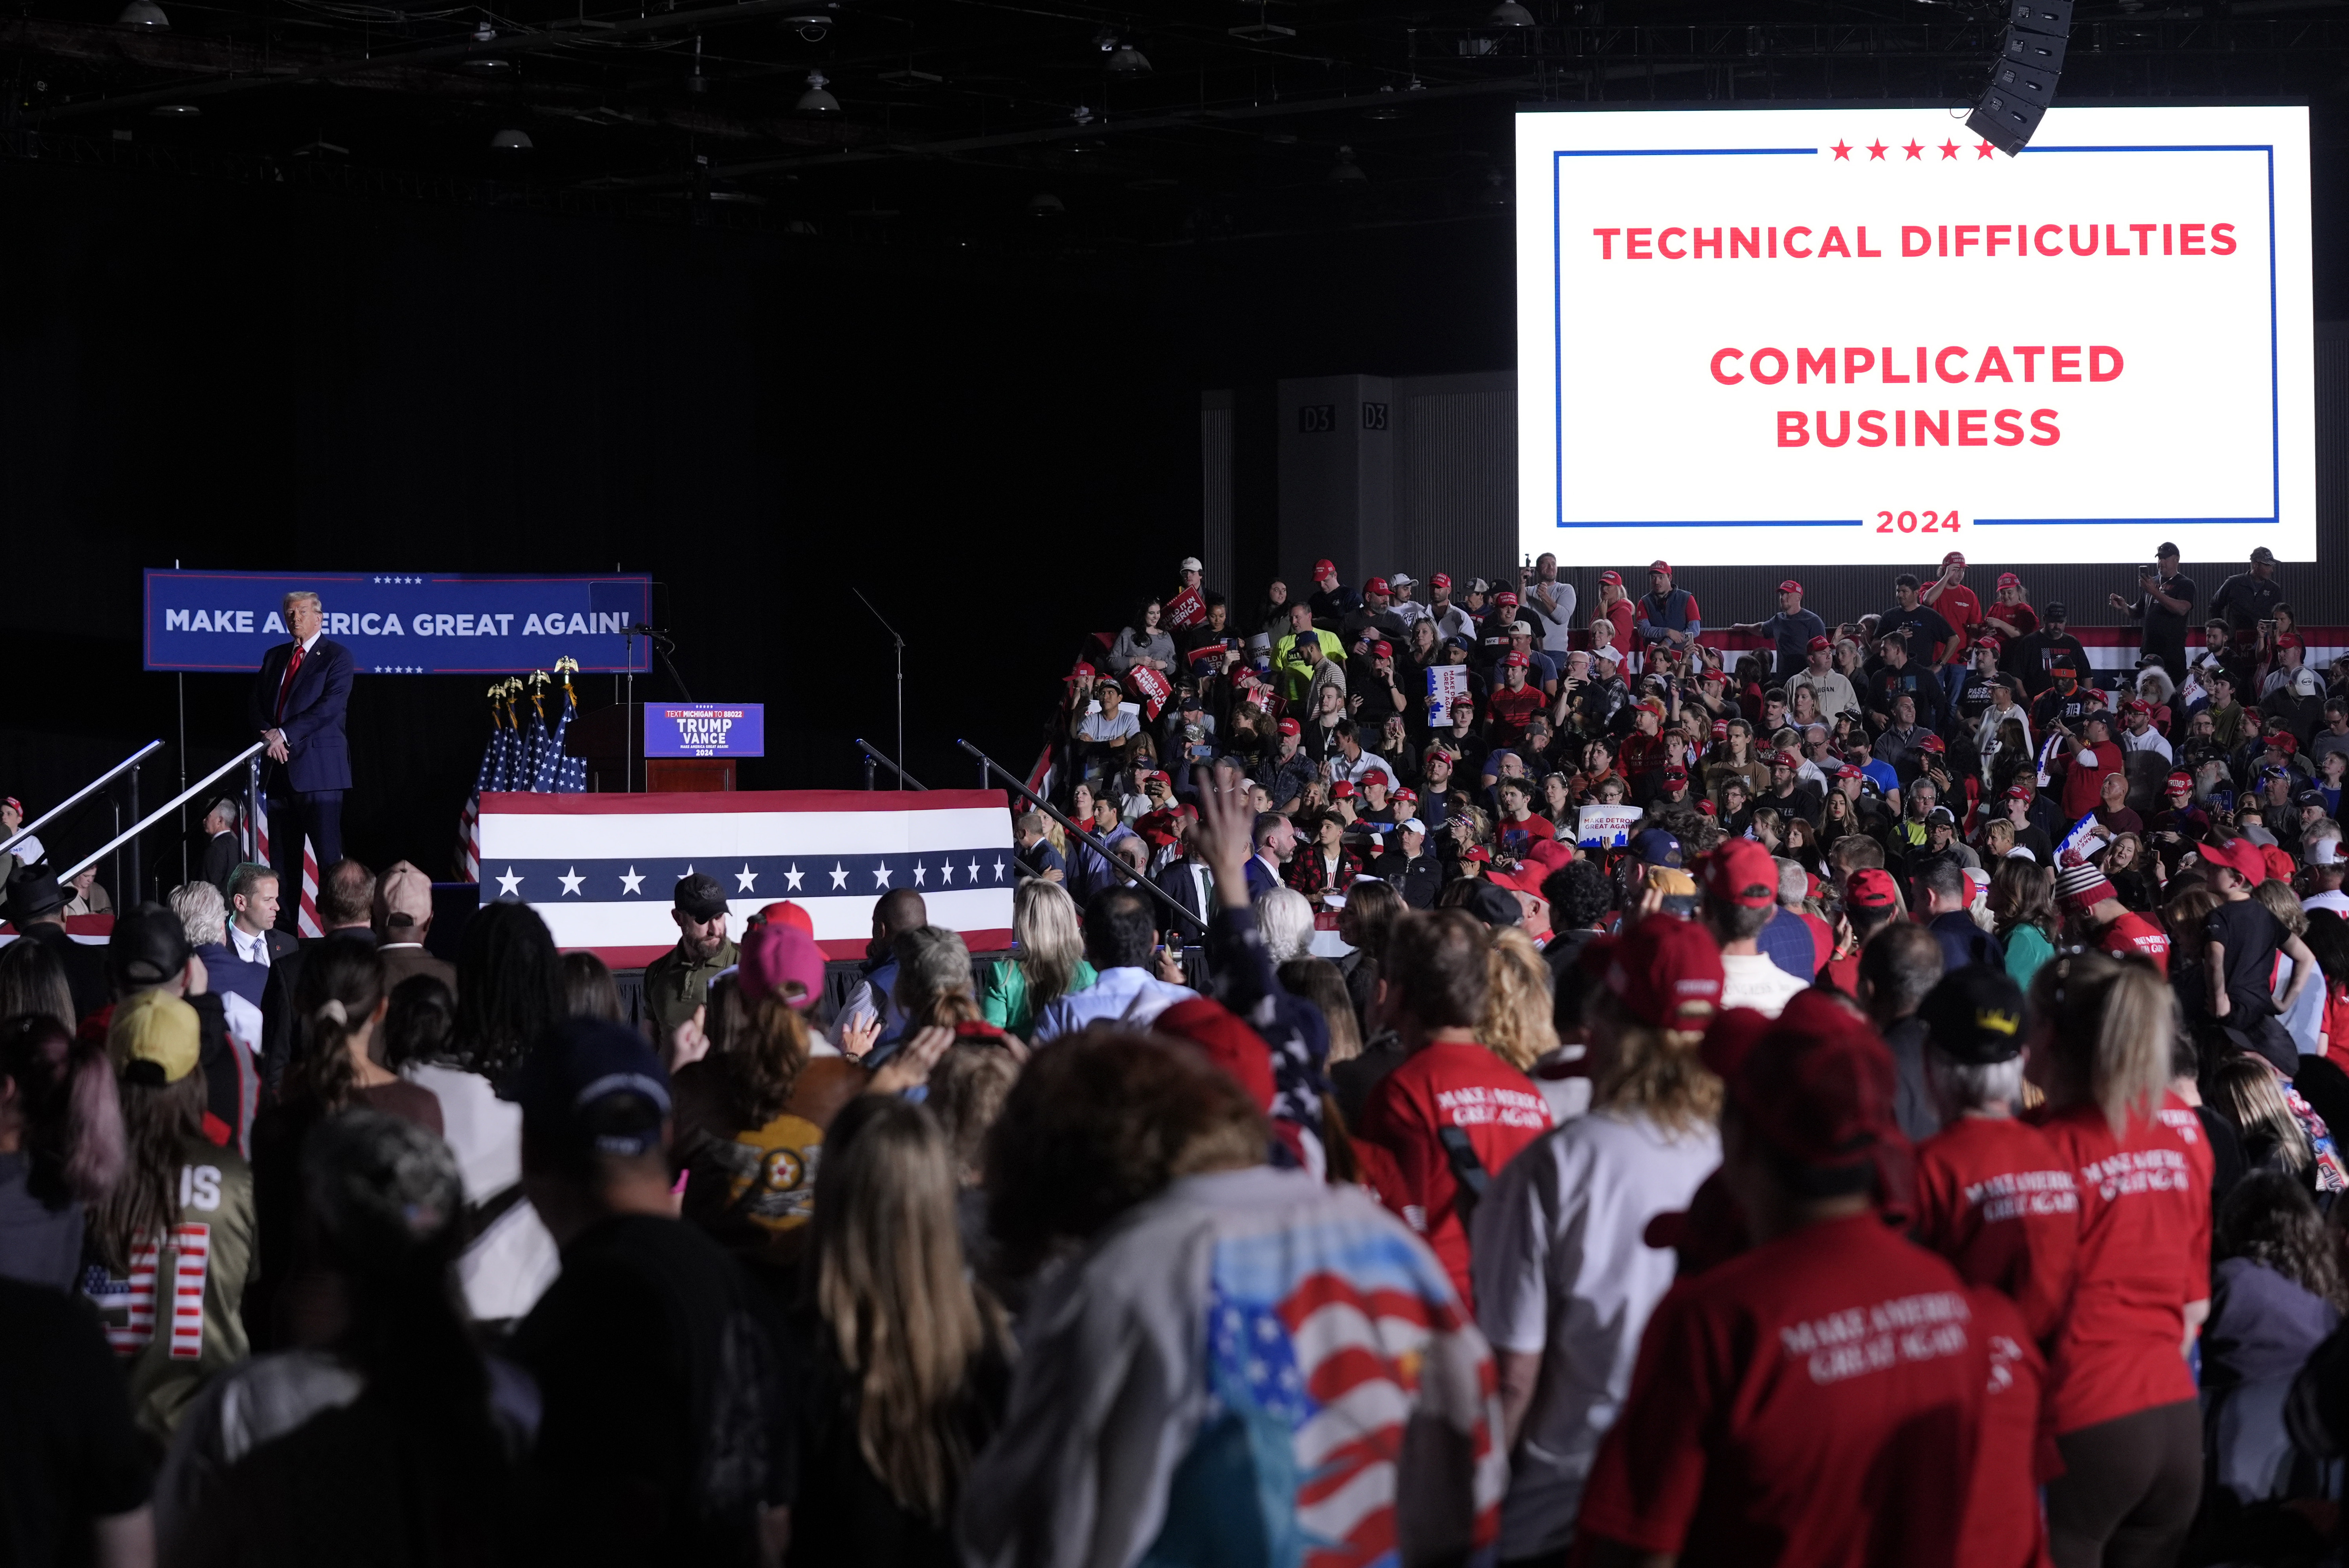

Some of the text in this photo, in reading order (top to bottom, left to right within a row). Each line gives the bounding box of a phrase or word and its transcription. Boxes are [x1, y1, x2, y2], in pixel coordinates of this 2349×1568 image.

[1594, 223, 2236, 259] TECHNICAL DIFFICULTIES
[1711, 346, 2124, 385] COMPLICATED
[1306, 406, 1328, 431] D3
[1366, 404, 1384, 429] D3
[1778, 409, 2060, 447] BUSINESS
[1877, 511, 1960, 533] 2024
[1187, 596, 1195, 605] IN
[166, 609, 629, 636] MAKE AERICA GREAT AGAIN!
[1134, 672, 1163, 711] AMERICA
[1140, 667, 1158, 689] BUILD
[1157, 688, 1164, 696] IT
[677, 719, 732, 732] TRUMP
[683, 733, 726, 744] VANCE
[2168, 779, 2185, 788] TRUMP
